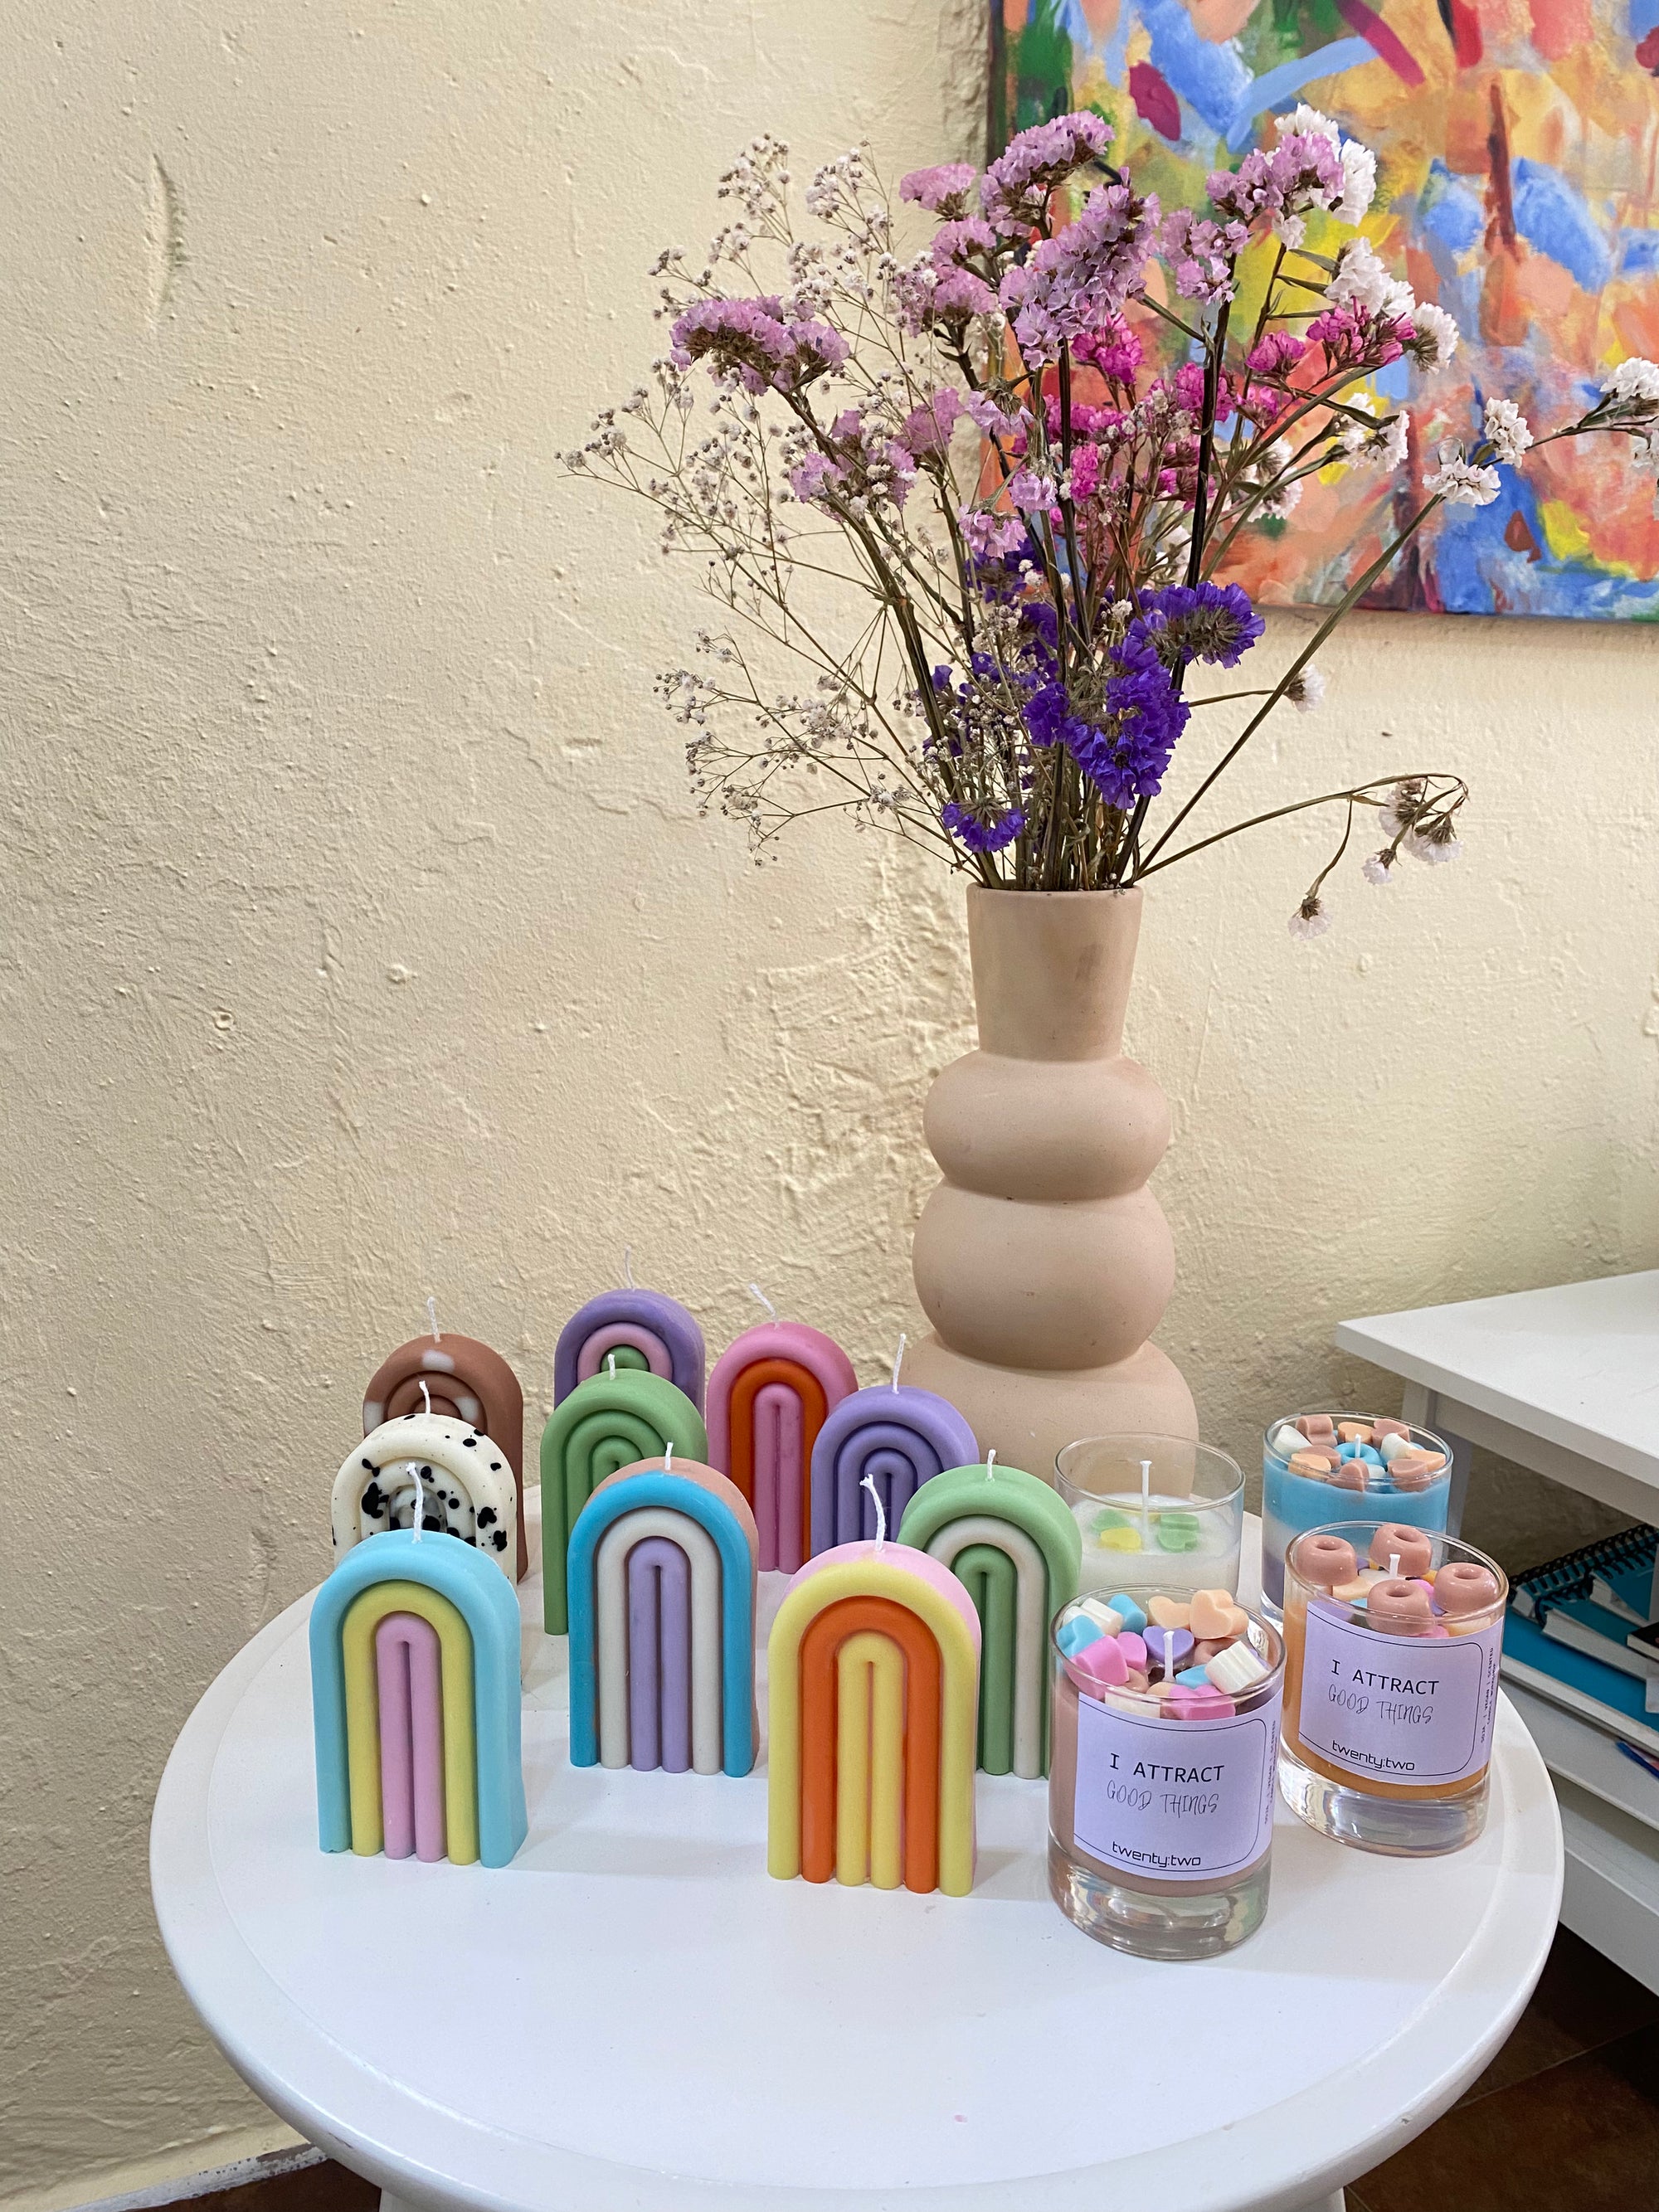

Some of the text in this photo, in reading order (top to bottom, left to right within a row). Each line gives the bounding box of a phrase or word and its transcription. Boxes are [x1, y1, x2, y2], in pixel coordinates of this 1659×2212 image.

[1331, 1660, 1440, 1694] I ATTRACT
[1328, 1684, 1434, 1725] GOOD THINGS
[1109, 1753, 1225, 1783] I ATTRACT
[1332, 1740, 1415, 1772] twenty:two
[1107, 1779, 1220, 1818] GOOD THINGS
[1112, 1841, 1201, 1868] twenty:two
